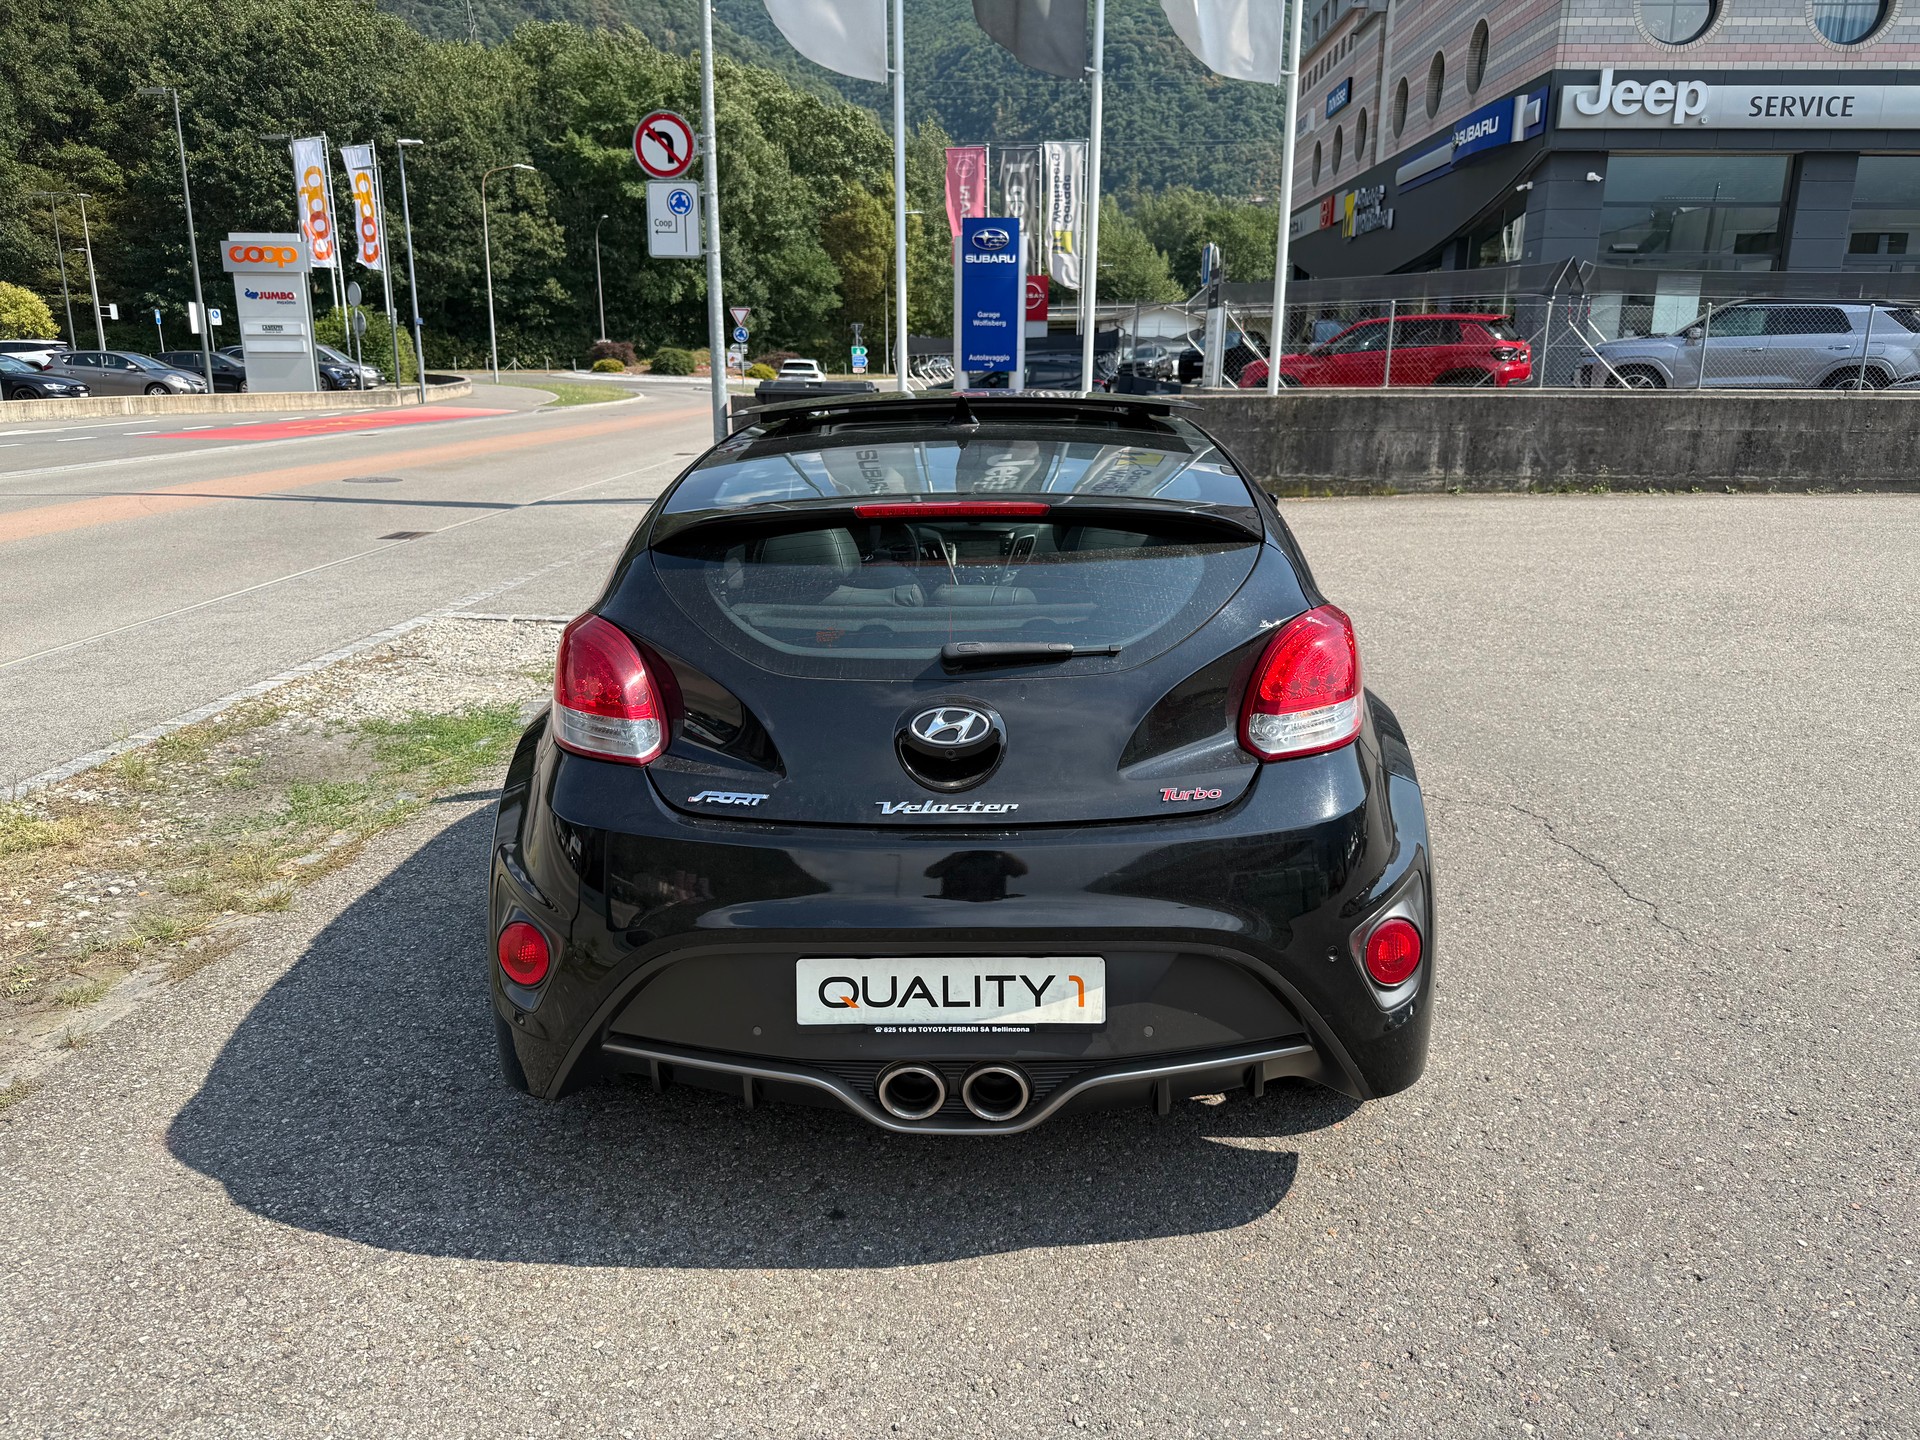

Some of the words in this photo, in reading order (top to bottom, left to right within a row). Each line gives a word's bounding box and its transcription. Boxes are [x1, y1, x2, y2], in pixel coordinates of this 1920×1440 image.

[1576, 67, 1709, 125] Jeep
[1748, 95, 1856, 118] SERVICE
[1459, 115, 1500, 147] SUBARU
[654, 218, 673, 229] Coop
[229, 245, 298, 268] coop
[965, 254, 1017, 264] SUBARU
[259, 291, 296, 300] JUMBO
[977, 311, 1001, 320] Garage
[973, 319, 1007, 328] Wolfisberg
[968, 354, 1010, 363] Autolavaggio
[688, 790, 770, 806] SPORT
[1159, 787, 1222, 802] Turbo
[818, 974, 1056, 1009] QUALITY
[1068, 975, 1085, 1008] 1
